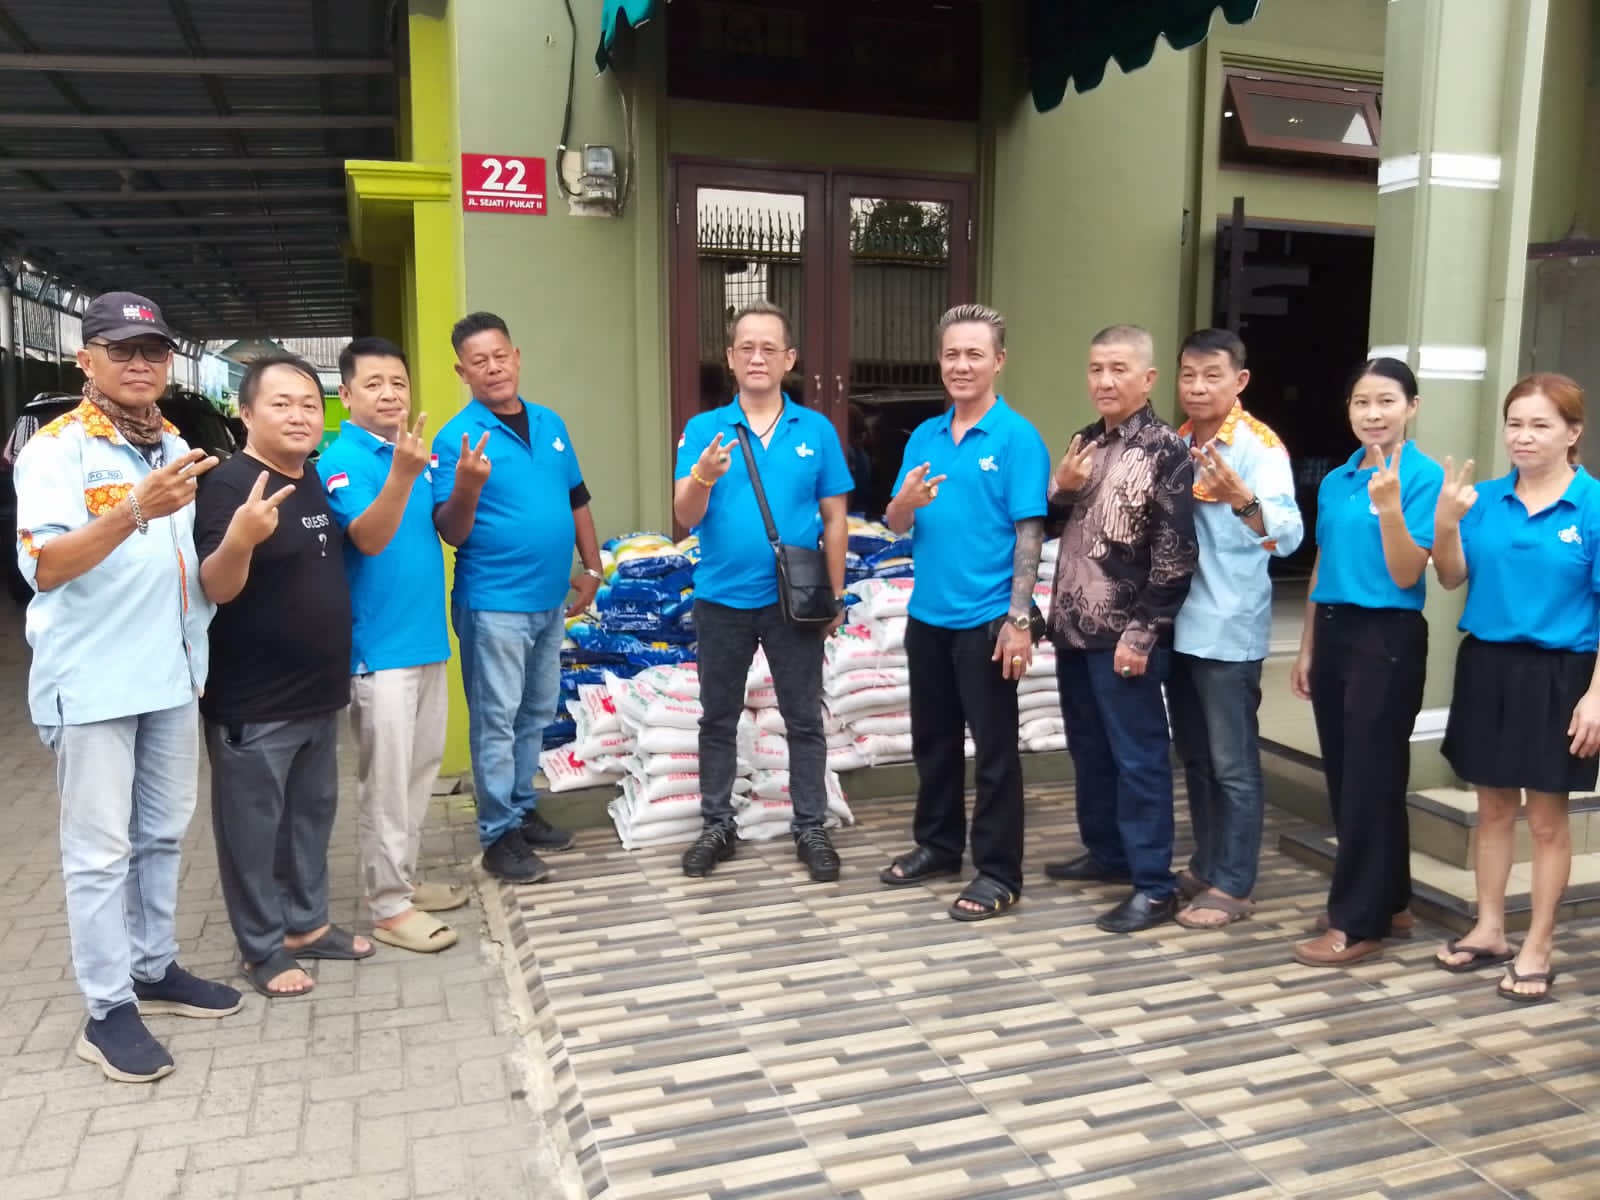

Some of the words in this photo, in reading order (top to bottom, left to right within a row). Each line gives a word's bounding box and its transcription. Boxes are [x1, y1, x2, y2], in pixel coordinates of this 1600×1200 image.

[481, 158, 527, 192] 22
[480, 198, 504, 207] SEJATI
[302, 513, 329, 529] GUESS
